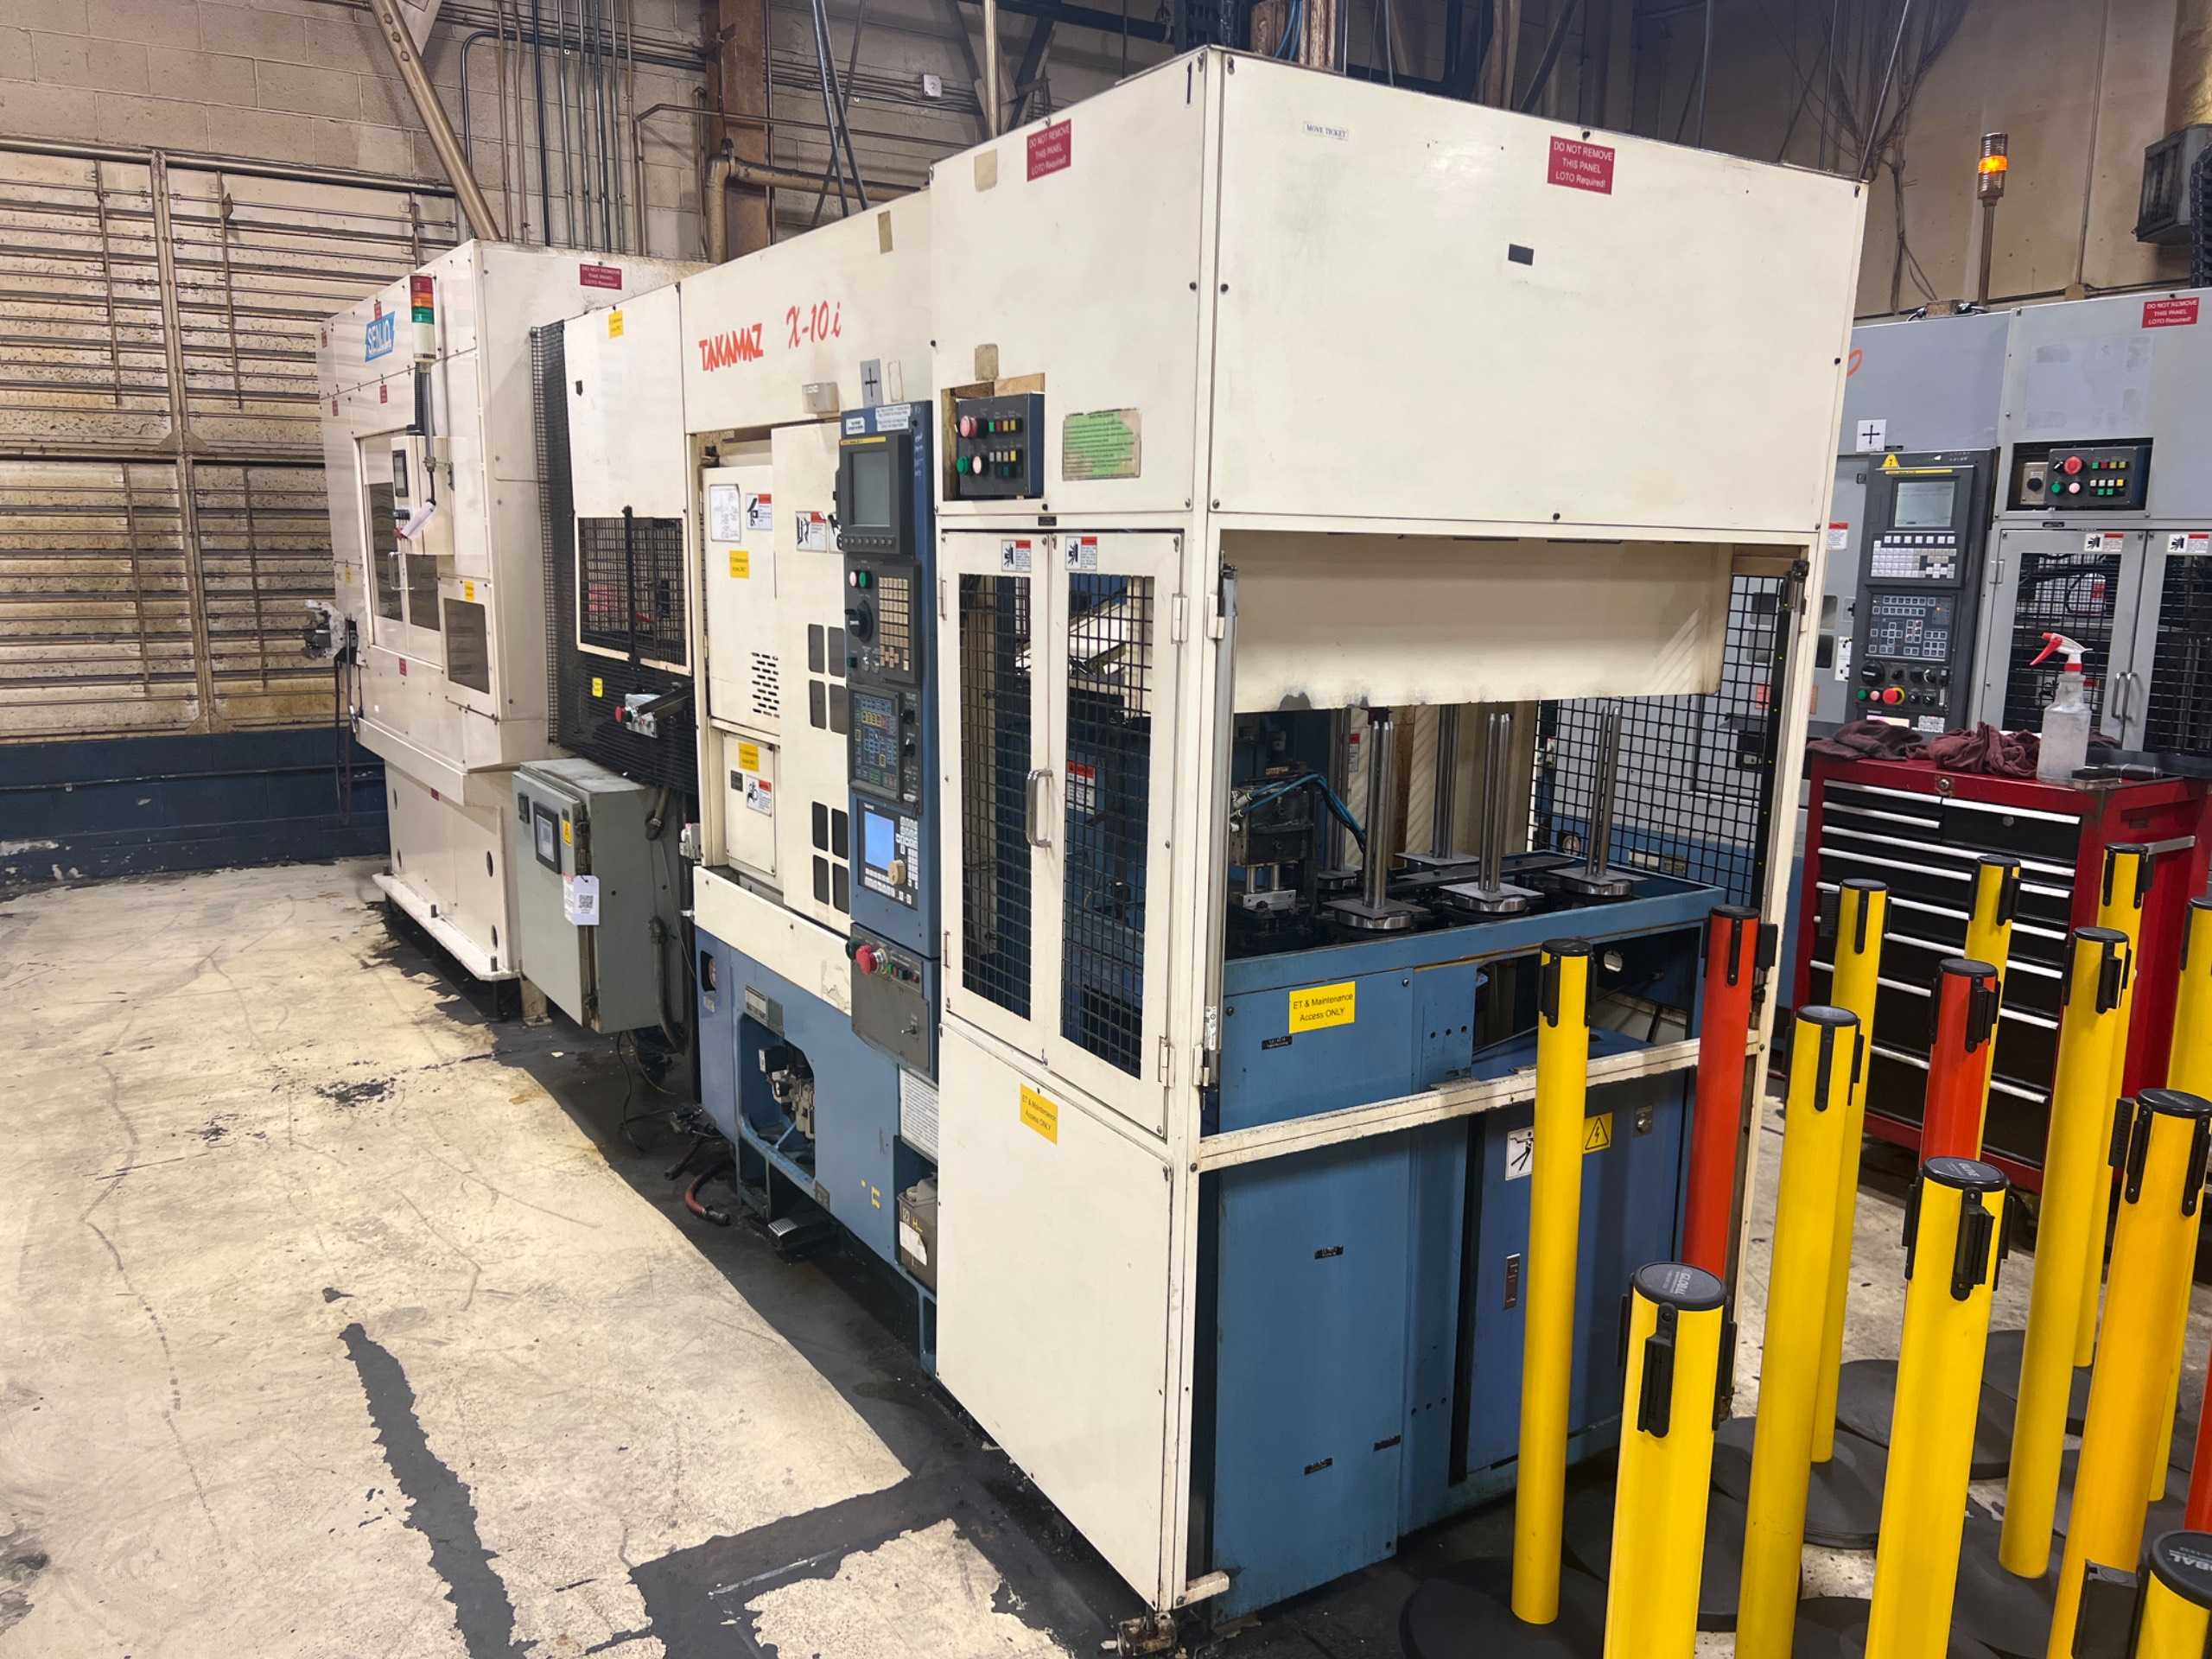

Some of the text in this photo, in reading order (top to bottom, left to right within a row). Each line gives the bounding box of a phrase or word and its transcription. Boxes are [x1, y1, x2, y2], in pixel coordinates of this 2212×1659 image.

[1554, 141, 1614, 162] DO NOT REMOVE
[1561, 156, 1601, 174] THIS PANEL
[1555, 171, 1575, 182] LOTO
[698, 322, 764, 372] TAKAMAZ
[1293, 993, 1354, 1010] ET & Maintenance
[1300, 1007, 1345, 1021] Access ONLY
